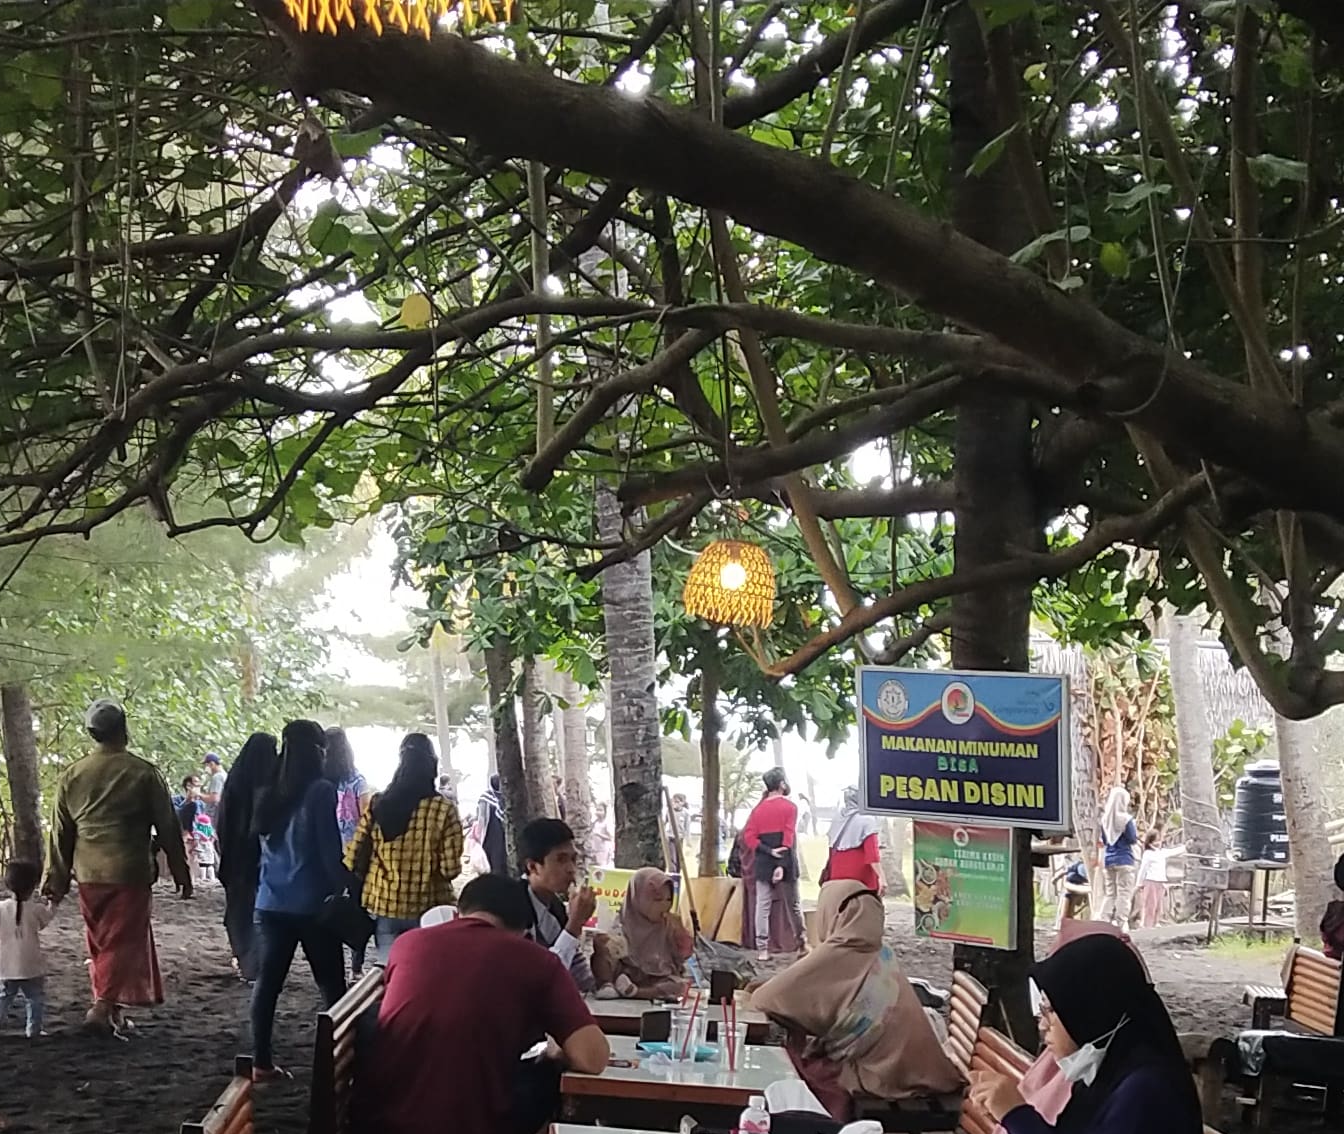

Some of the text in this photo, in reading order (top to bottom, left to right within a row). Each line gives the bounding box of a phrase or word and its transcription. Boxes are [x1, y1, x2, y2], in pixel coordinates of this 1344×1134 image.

[881, 735, 1038, 759] MAKANAN MINUMAN
[937, 756, 979, 774] BISA
[880, 774, 1045, 808] PESAN DISINI
